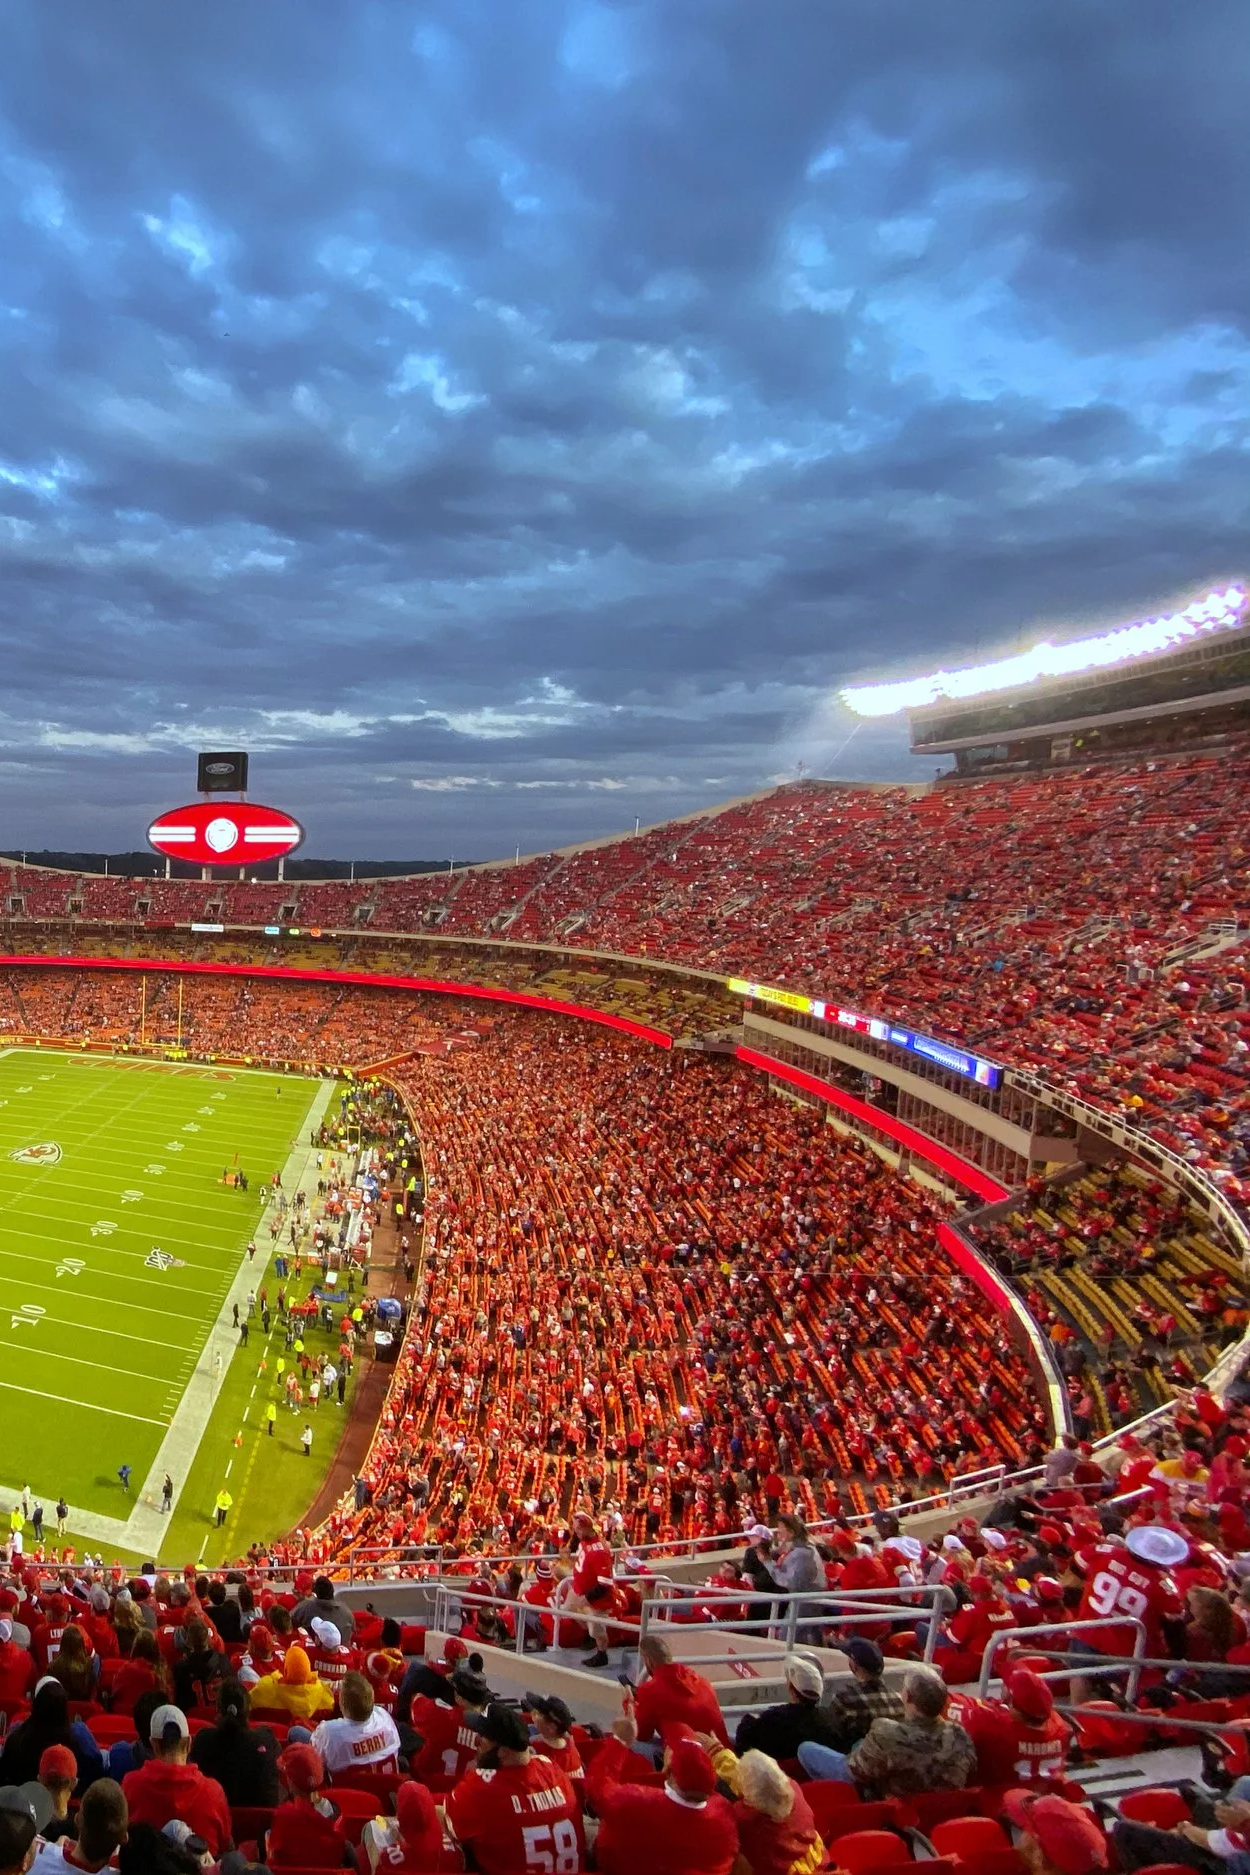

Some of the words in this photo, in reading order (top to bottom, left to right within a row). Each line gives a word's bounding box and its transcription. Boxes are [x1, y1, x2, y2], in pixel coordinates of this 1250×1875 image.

[91, 1220, 118, 1236] 30
[55, 1257, 86, 1277] 20
[11, 1304, 47, 1327] 10
[1088, 1571, 1148, 1618] 99
[352, 1731, 387, 1757] BERRY
[526, 1785, 567, 1813] THOMAS
[521, 1818, 580, 1875] 58
